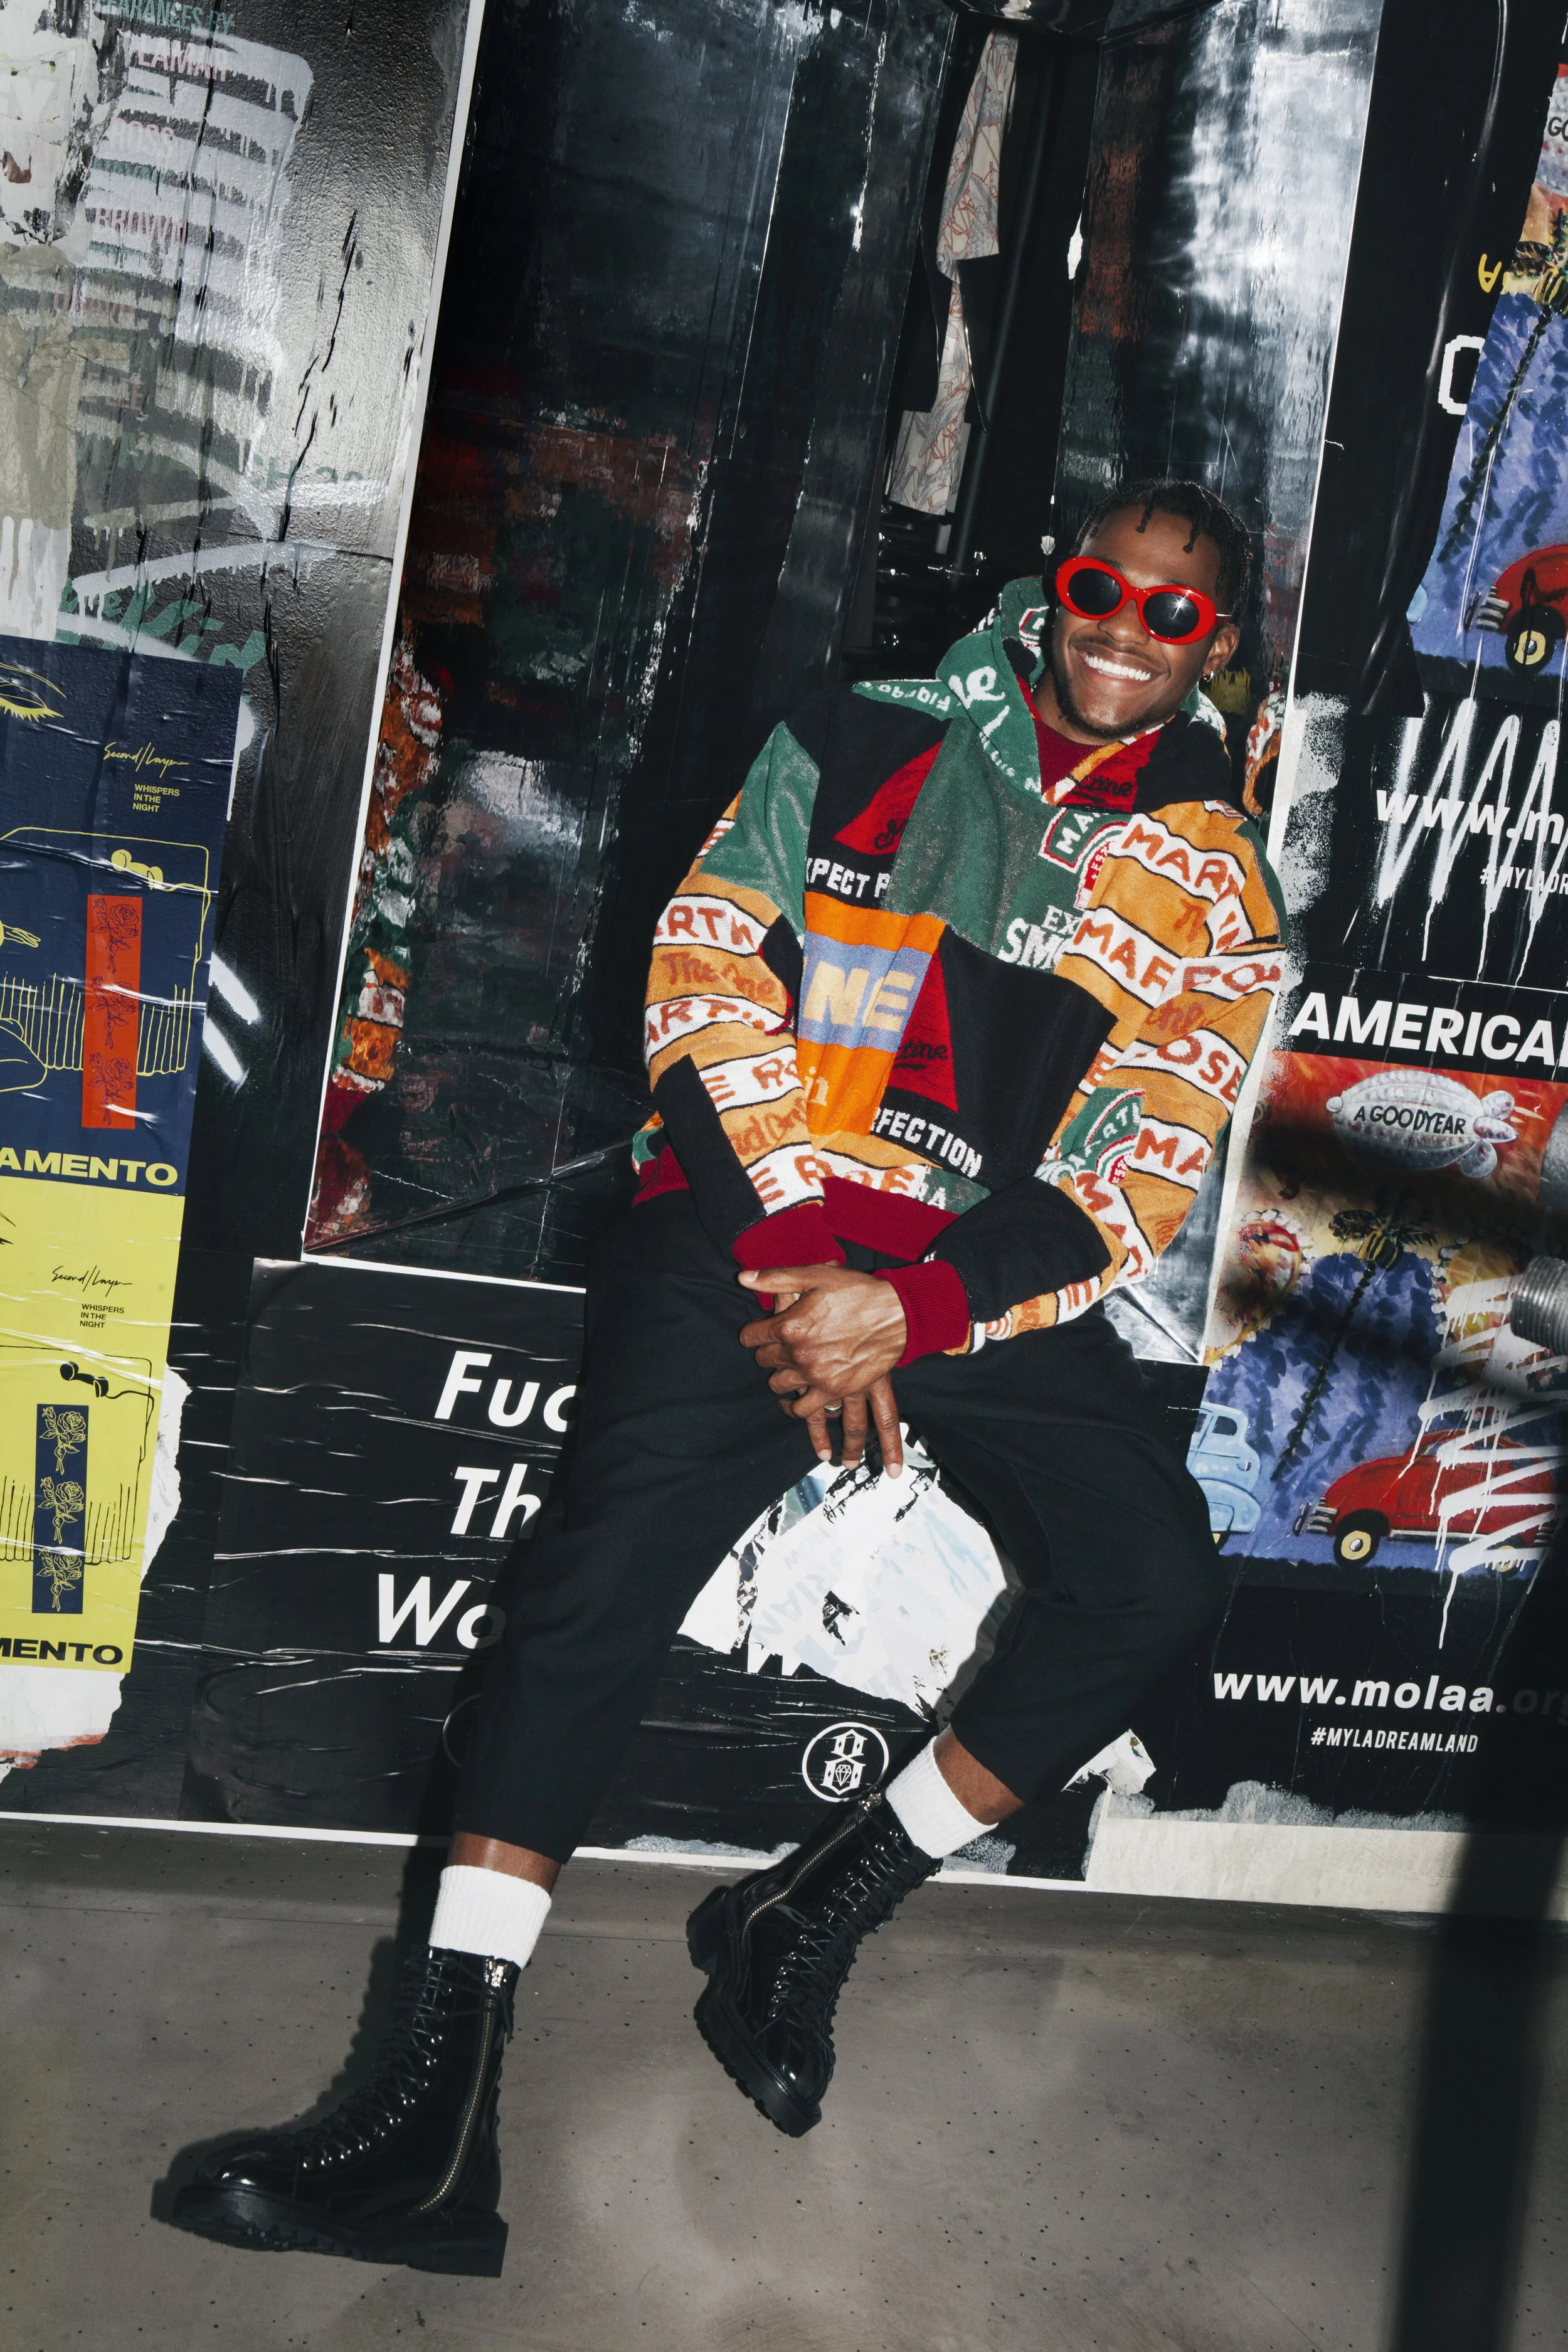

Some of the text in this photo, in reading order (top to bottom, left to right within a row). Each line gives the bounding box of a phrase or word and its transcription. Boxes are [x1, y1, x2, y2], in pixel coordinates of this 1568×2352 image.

[134, 783, 181, 797] WHISPERS
[134, 794, 161, 803] IN THE
[132, 803, 160, 813] NIGHT
[802, 957, 916, 1034] NE
[1289, 992, 1568, 1068] AMERICA
[1354, 1104, 1466, 1135] A GOODYEAR
[0, 1147, 179, 1187] AMENTO
[82, 1303, 125, 1314] WHISPERS
[80, 1321, 105, 1329] NIGHT
[1311, 1727, 1478, 1753] #MYLADREAMLAND
